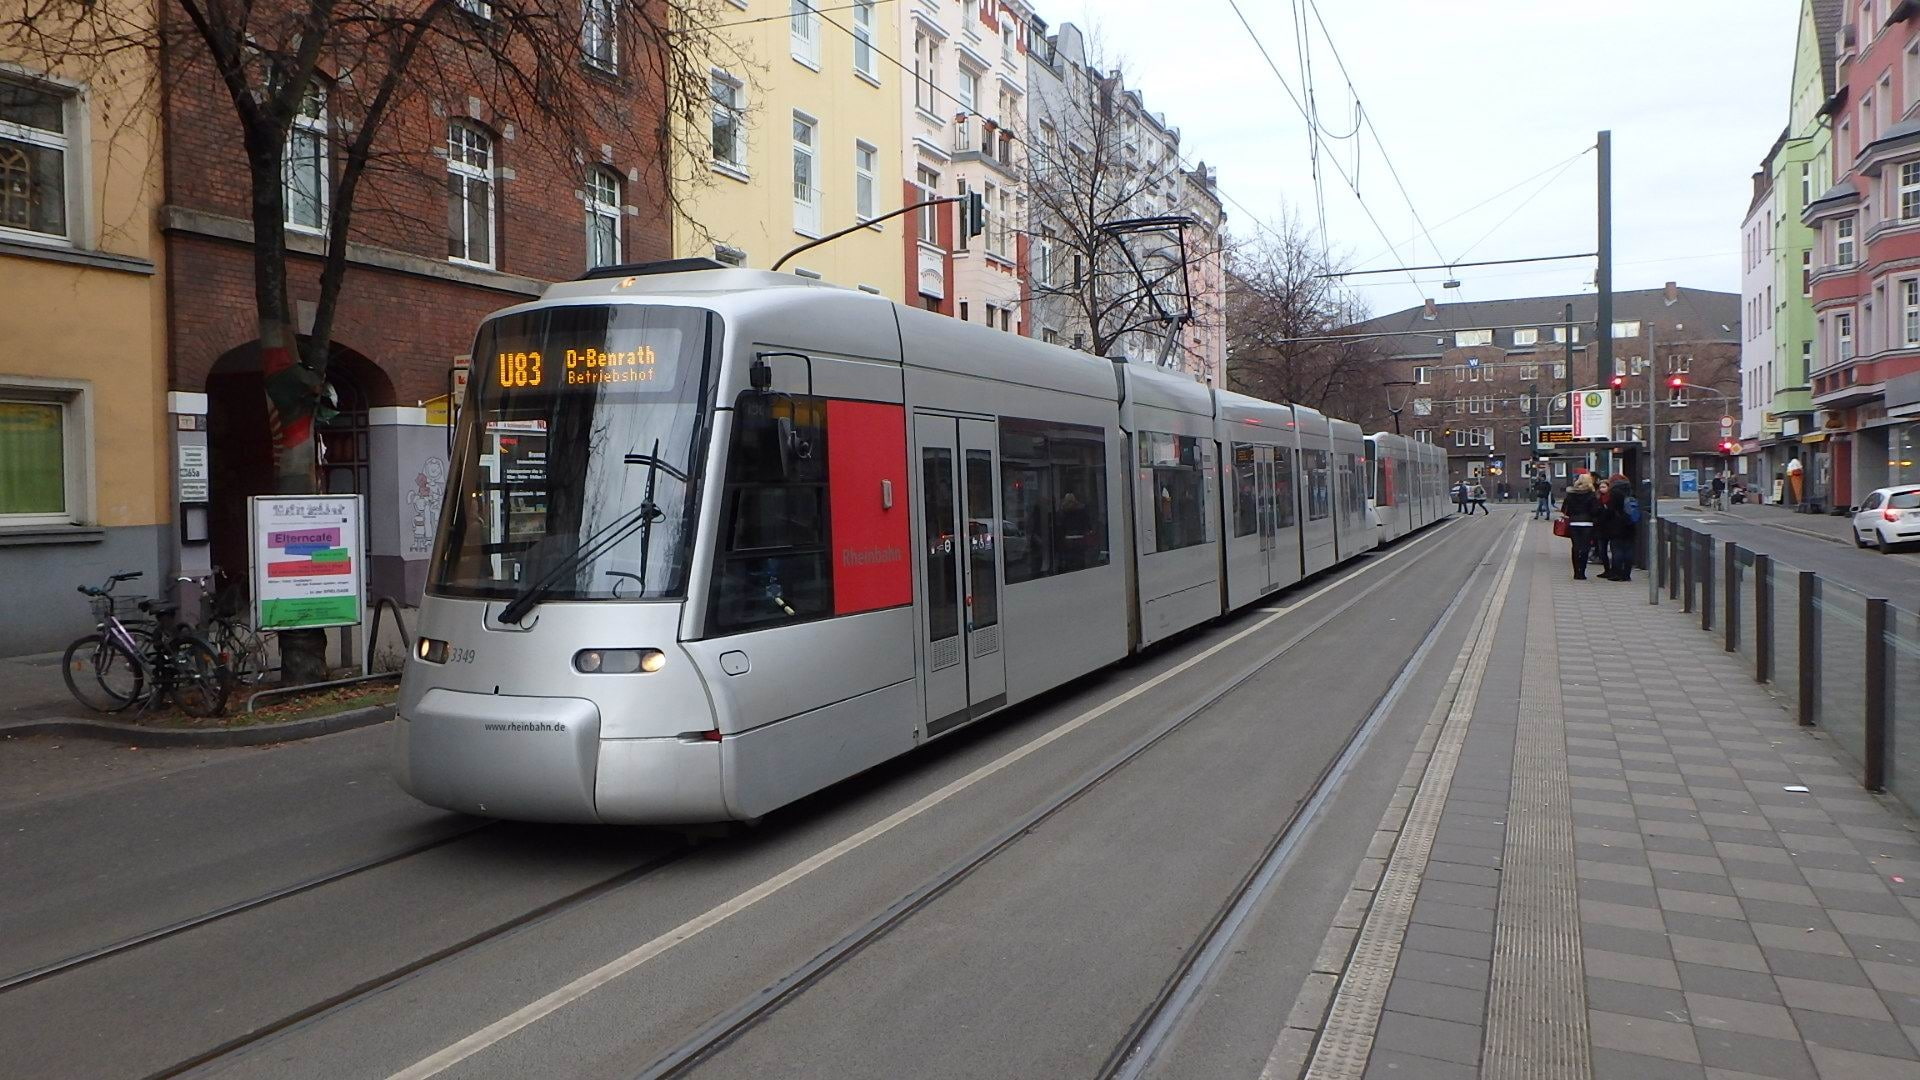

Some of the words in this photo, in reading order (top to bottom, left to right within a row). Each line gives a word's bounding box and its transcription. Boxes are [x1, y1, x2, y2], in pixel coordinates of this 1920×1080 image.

[499, 352, 543, 387] U83
[566, 346, 656, 368] D-Benrath
[568, 369, 655, 384] Betriebshof
[843, 545, 902, 568] Rheinbahn
[451, 648, 476, 664] 3349
[484, 721, 566, 732] www.rheinbahn.de
